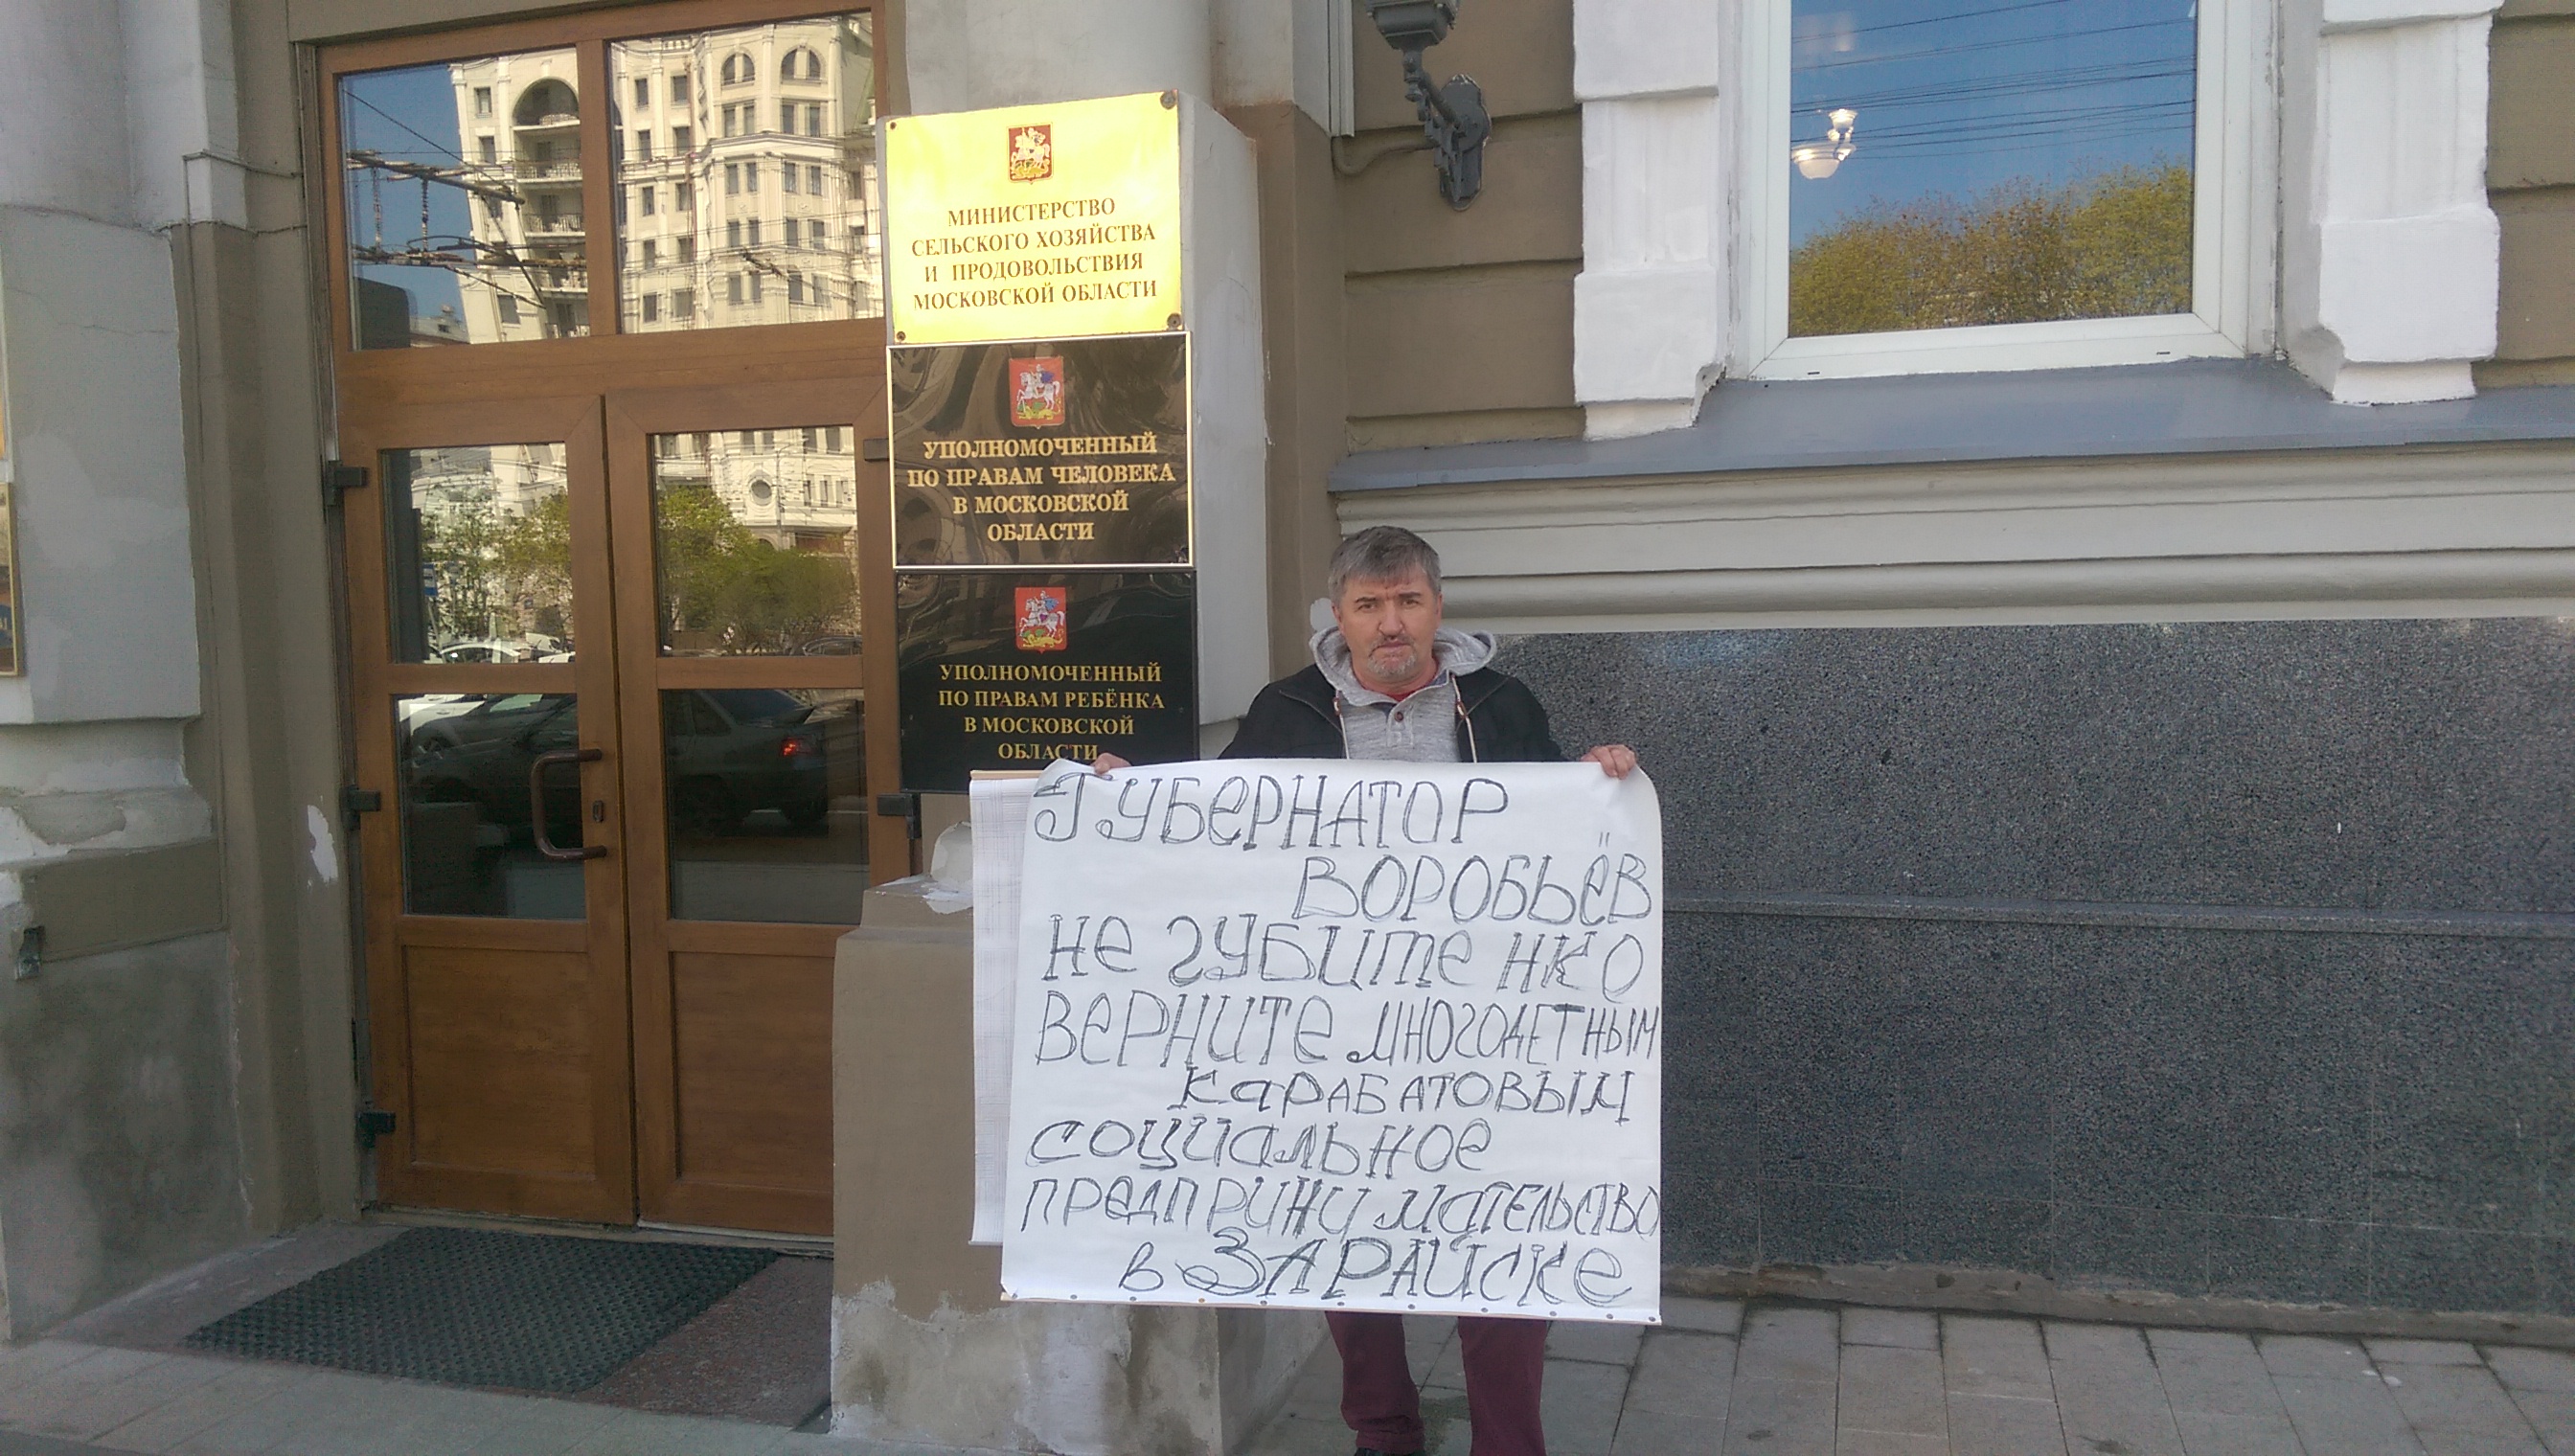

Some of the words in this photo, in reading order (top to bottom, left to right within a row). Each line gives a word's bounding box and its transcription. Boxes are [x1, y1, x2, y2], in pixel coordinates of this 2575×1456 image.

[947, 197, 1116, 227] МИНИСТЕРСТВО
[911, 231, 1029, 257] СЕЛЬСКОГО
[1037, 222, 1156, 249] ХОЗЯЙСТВА
[924, 265, 938, 283] И
[952, 252, 1144, 282] ПРОДОВОЛЬСТВИЯ
[913, 282, 1055, 311] МОСКОВСКОЙ
[1061, 280, 1157, 303] ОБЛАСТИ
[923, 431, 1158, 460] УПОЛНОМОЧЕННЫЙ
[907, 469, 940, 488] ПО
[946, 466, 1043, 487] ПРАВАМ
[1050, 463, 1176, 485] ЧЕЛОВЕКА
[952, 497, 968, 514] В
[974, 489, 1129, 514] МОСКОВСКОЙ
[987, 522, 1095, 542] ОБЛАСТИ
[939, 661, 1162, 683] УПОЛНОМОЧЕННЫЙ
[939, 690, 968, 707] ПО
[974, 691, 1059, 708] ПРАВАМ
[1064, 688, 1166, 710] РЕБЁНКА
[964, 717, 977, 734] В
[982, 715, 1135, 736] МОСКОВСКОЙ
[997, 743, 1099, 762] ОБЛАСТИ
